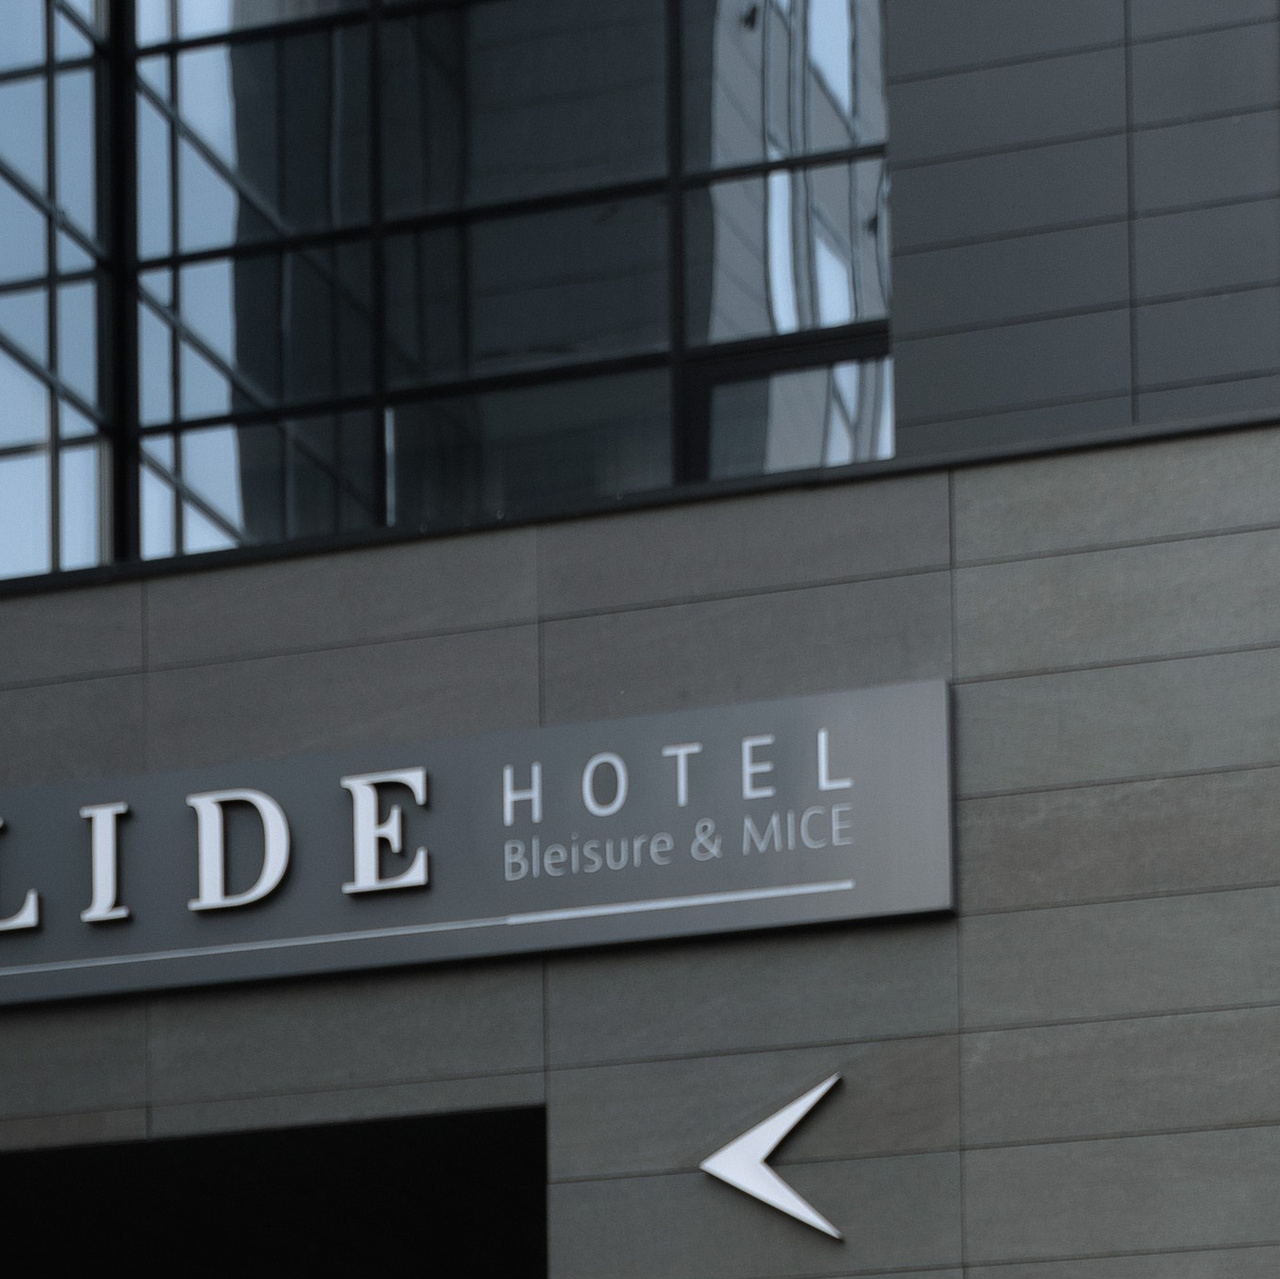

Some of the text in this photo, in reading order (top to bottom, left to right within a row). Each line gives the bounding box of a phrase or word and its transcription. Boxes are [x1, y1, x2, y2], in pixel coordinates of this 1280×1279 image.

[502, 728, 854, 827] HOTEL
[503, 803, 856, 882] Bleisure & MICE
